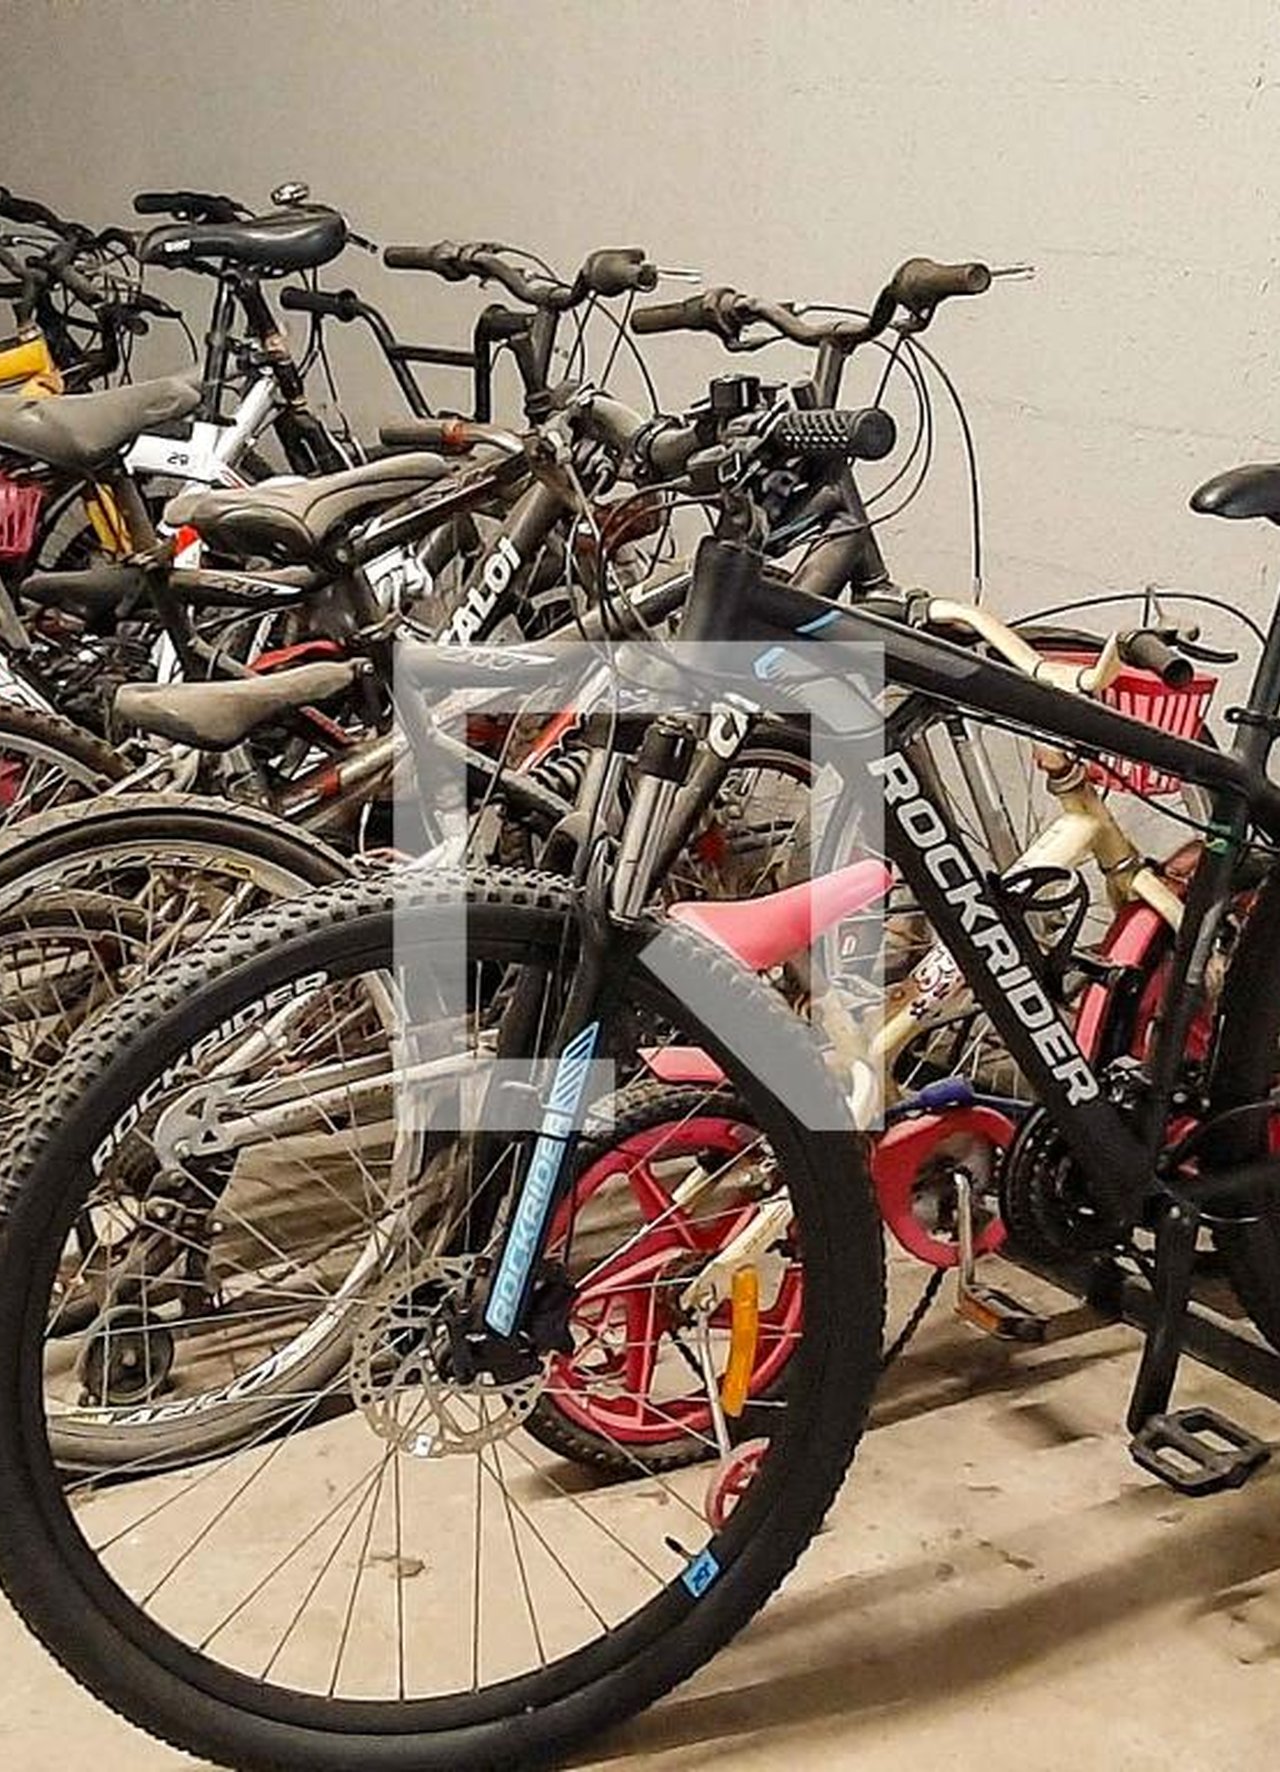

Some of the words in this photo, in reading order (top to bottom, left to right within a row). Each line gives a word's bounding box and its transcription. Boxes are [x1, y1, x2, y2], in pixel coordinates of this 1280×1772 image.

[867, 751, 1100, 1107] ROCKRIDER
[92, 970, 328, 1177] ROCKRIDER
[489, 1112, 575, 1322] ROCKRIDER
